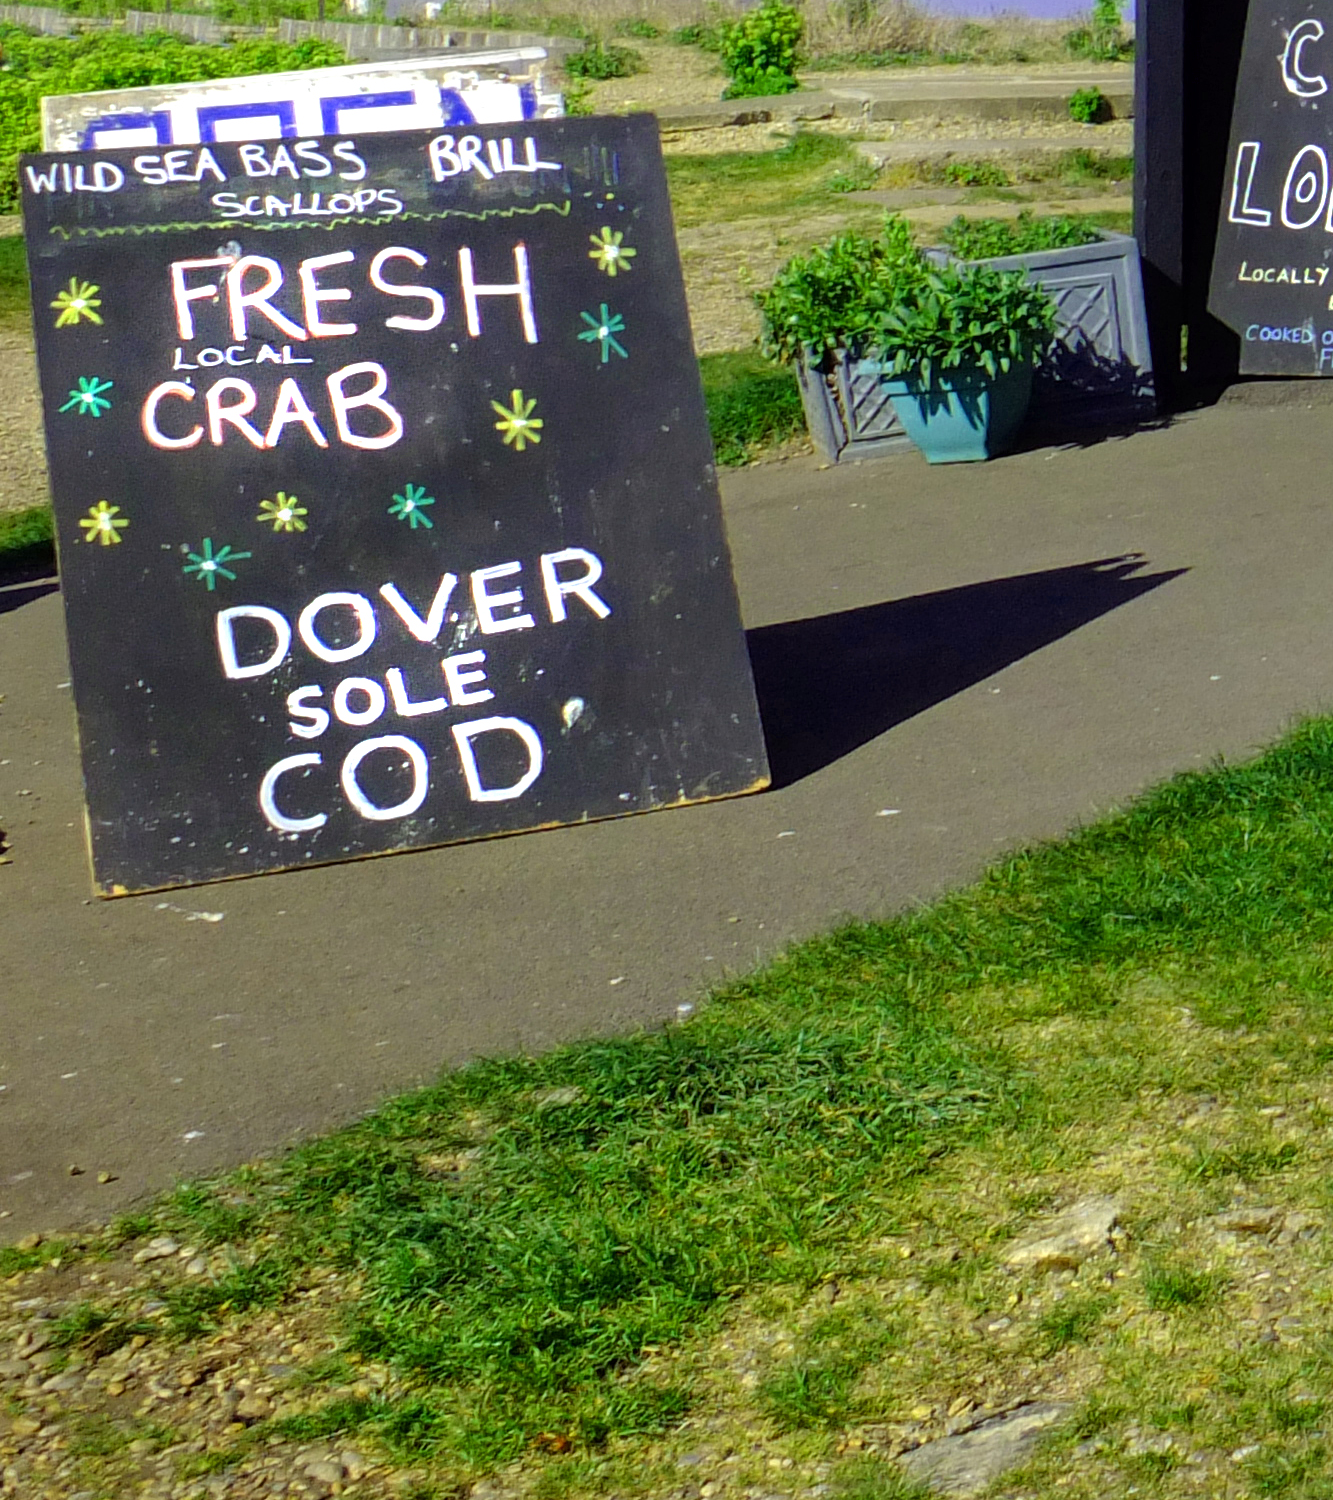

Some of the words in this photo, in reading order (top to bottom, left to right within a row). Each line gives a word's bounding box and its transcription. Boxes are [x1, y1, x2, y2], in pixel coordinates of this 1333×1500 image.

[25, 162, 124, 194] WILD
[134, 150, 226, 184] SEA
[238, 140, 367, 181] BASS
[427, 134, 563, 184] BRILL
[211, 189, 403, 218] SCALLOPS
[170, 241, 539, 344] FRESH
[1238, 261, 1330, 287] LOCALLY
[172, 344, 313, 371] LOCAL
[1245, 324, 1314, 344] COOKED
[141, 361, 403, 451] CRAB
[217, 547, 612, 679] DOVER
[286, 649, 495, 739] SOLE
[259, 715, 545, 833] COD
